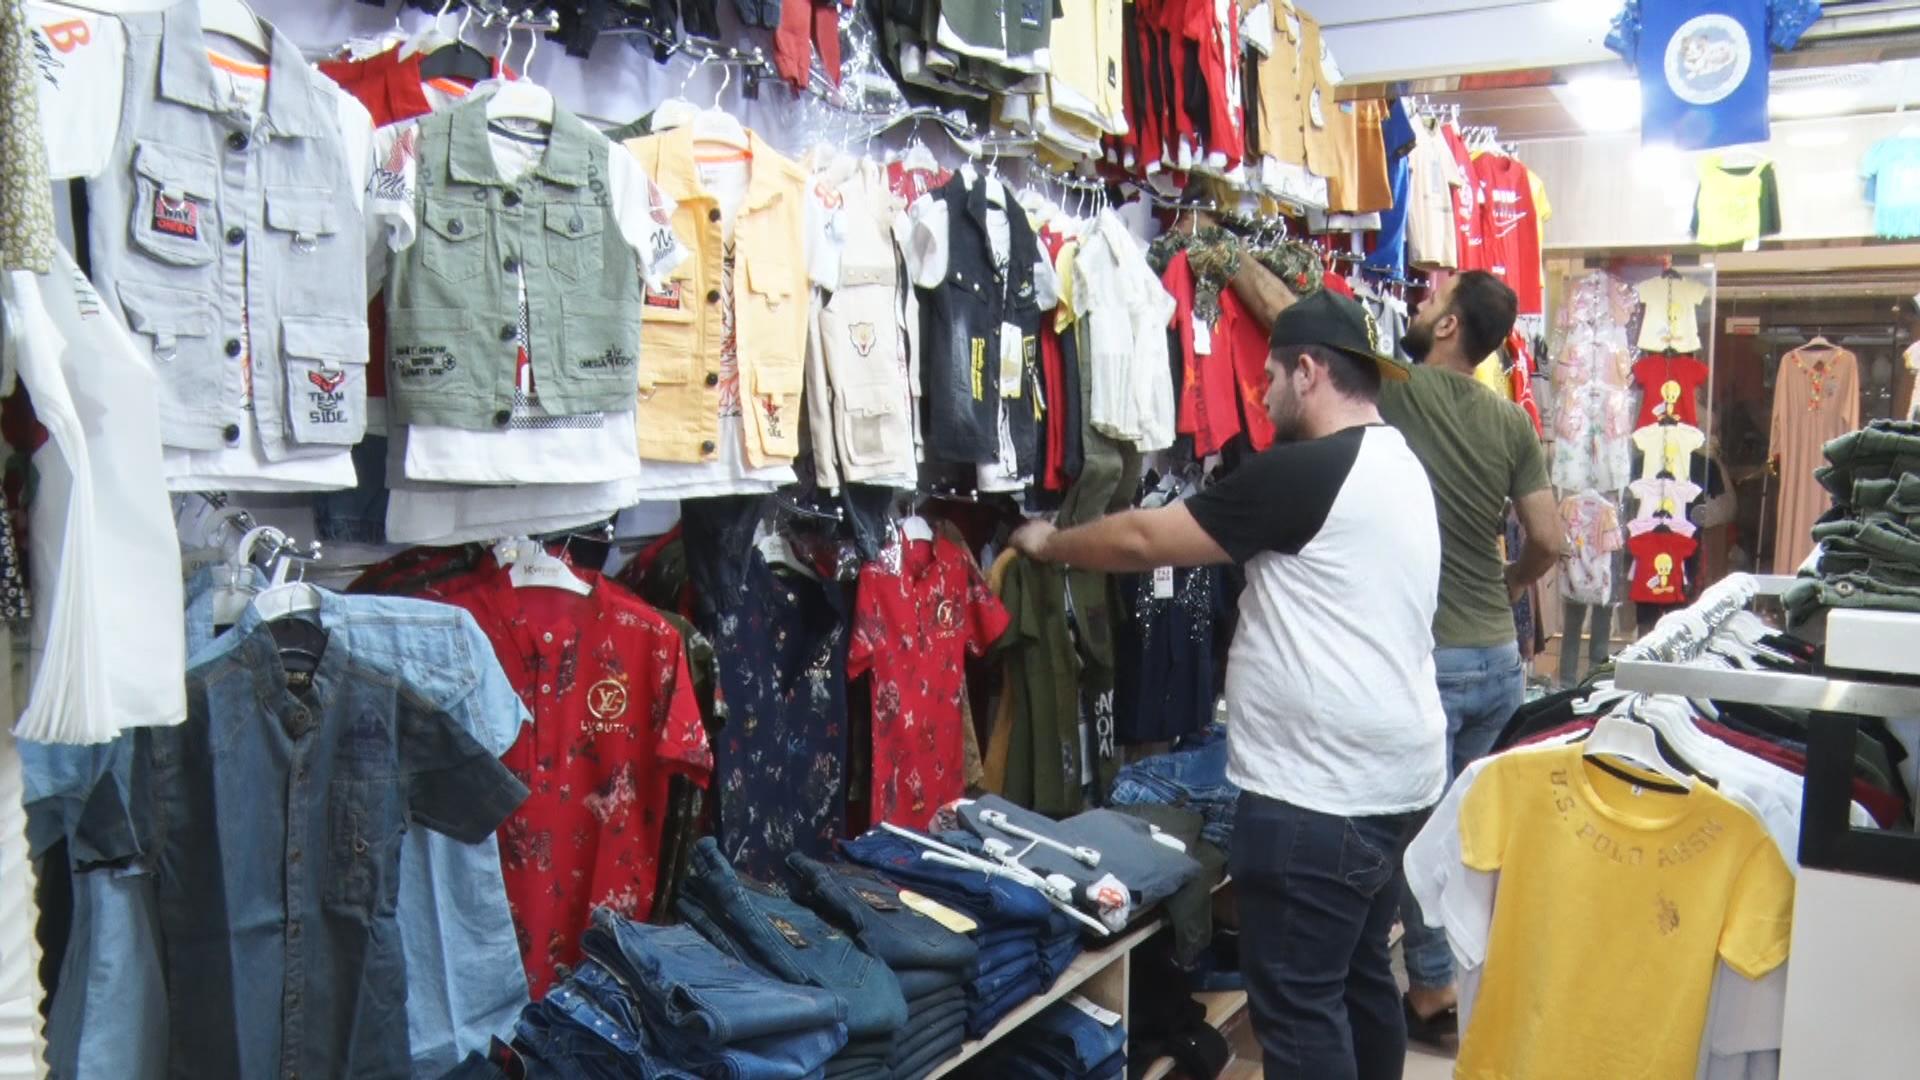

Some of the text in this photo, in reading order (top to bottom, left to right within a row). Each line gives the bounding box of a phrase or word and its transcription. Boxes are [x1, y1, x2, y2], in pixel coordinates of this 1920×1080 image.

[307, 391, 345, 402] TEAM
[309, 409, 348, 424] SIDE
[1576, 821, 1644, 866] POLO
